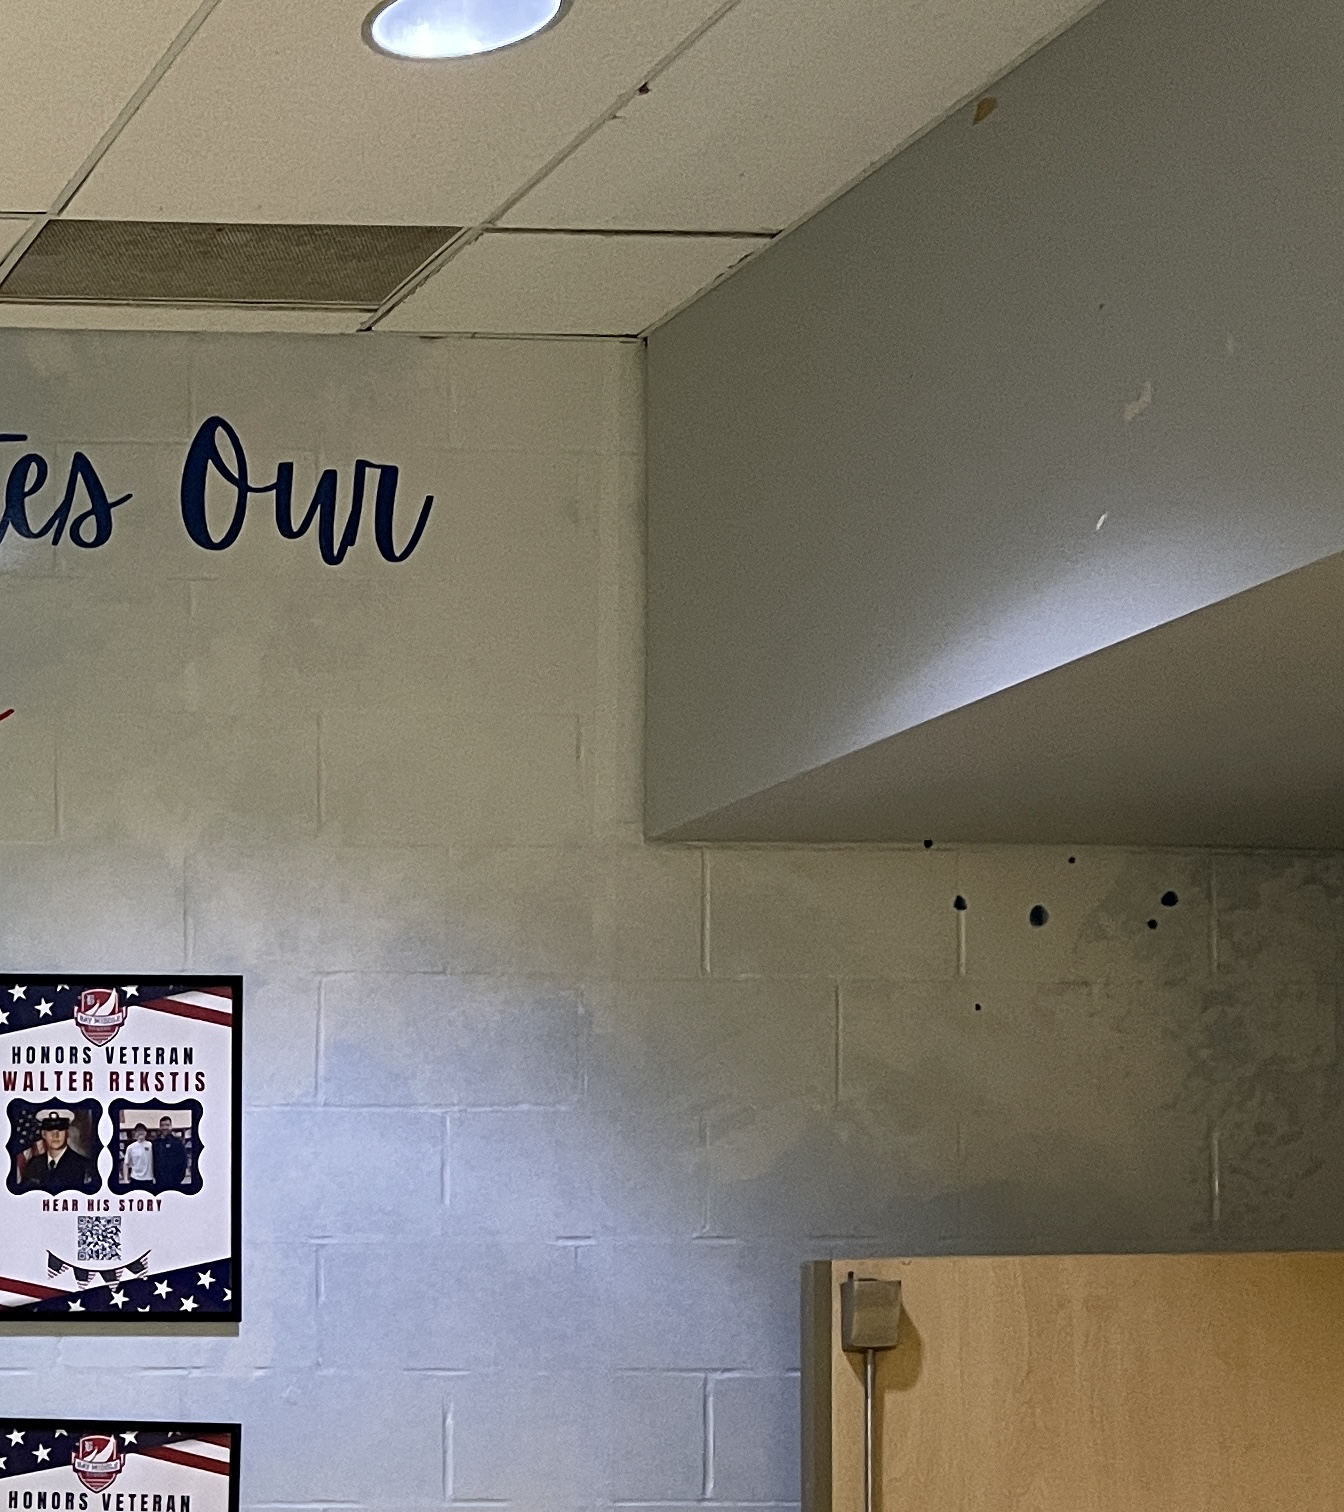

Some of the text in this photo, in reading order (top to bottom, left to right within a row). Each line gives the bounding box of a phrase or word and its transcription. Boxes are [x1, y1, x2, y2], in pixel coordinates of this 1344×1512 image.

[179, 415, 434, 566] Our
[12, 1046, 193, 1065] HONORS VETERAN
[3, 1071, 205, 1091] WALTER REKSTIS
[43, 1199, 161, 1211] HEAR HIS STORY
[9, 1491, 190, 1512] HONORS VETERAN
